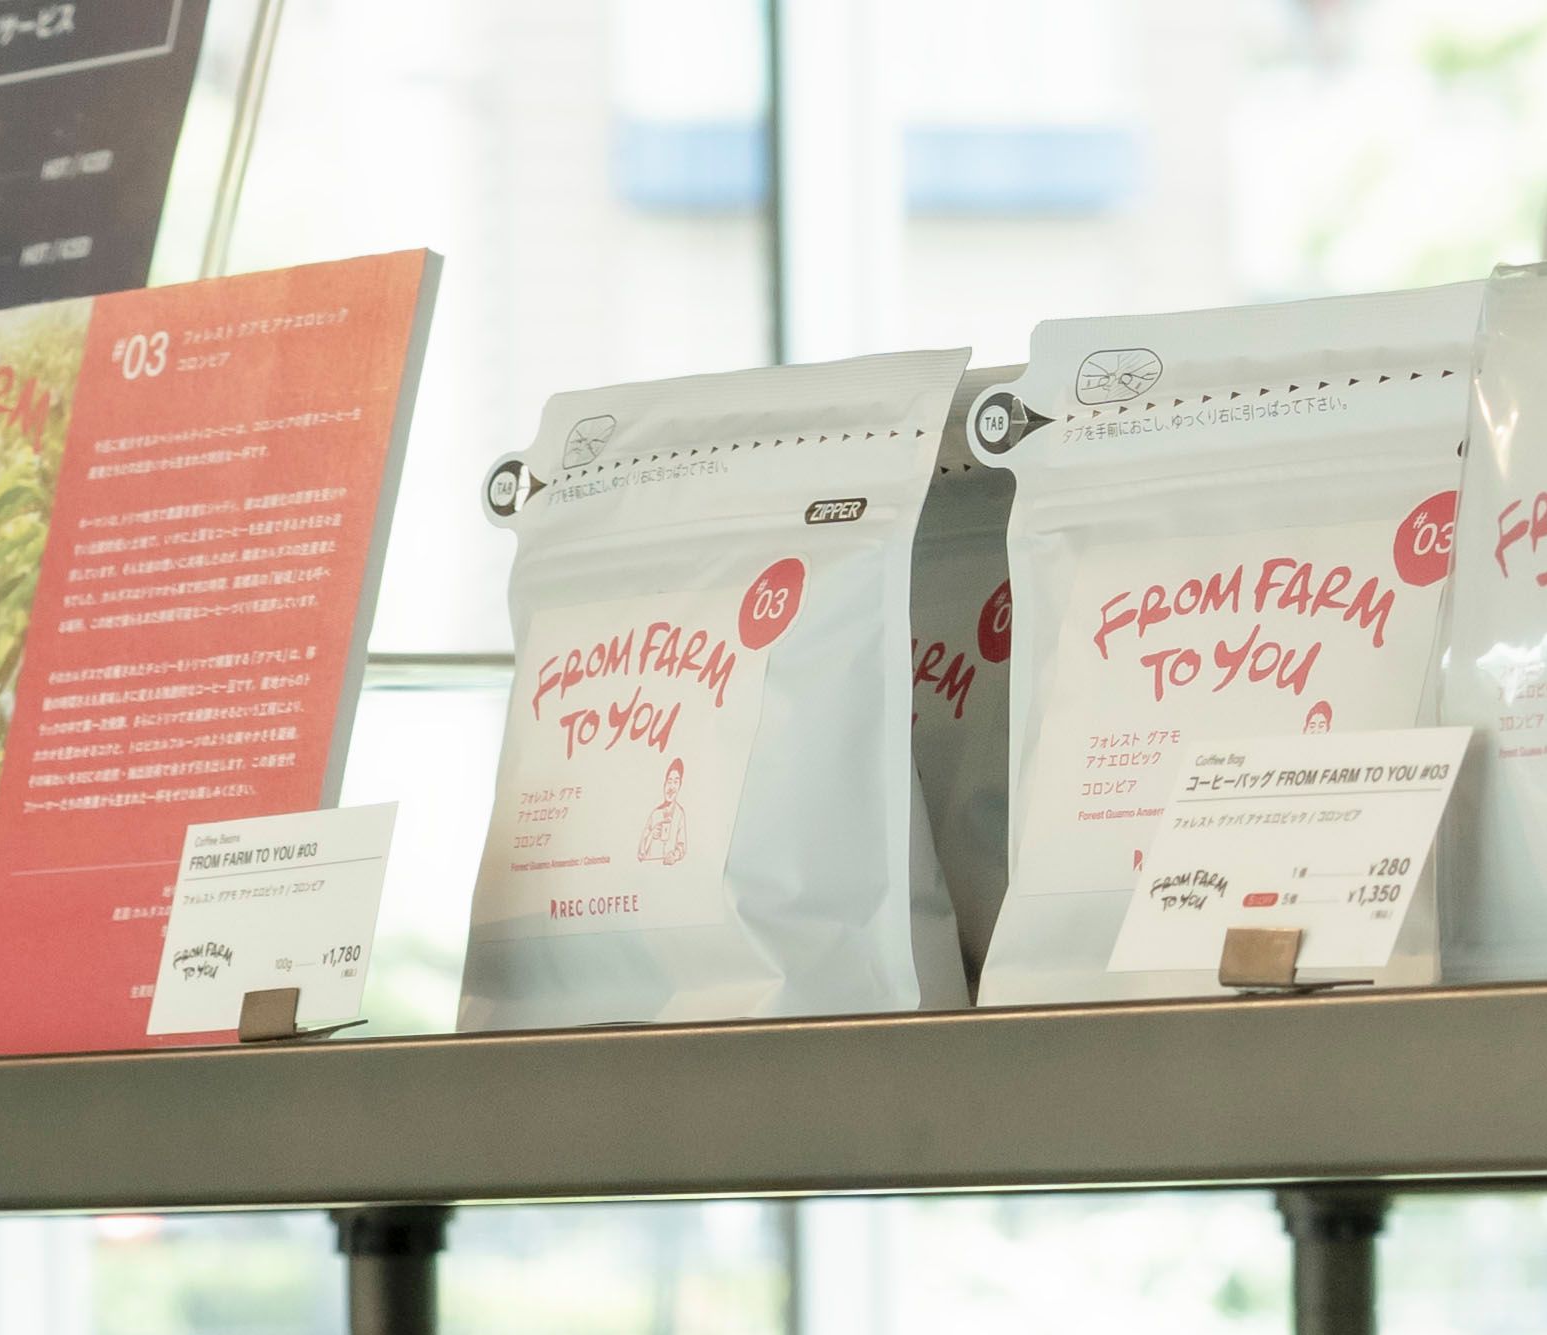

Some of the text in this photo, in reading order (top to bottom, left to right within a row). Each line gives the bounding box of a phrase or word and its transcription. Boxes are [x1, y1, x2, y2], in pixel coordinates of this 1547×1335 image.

[112, 331, 170, 380] #03
[984, 415, 1006, 431] TAB
[810, 500, 861, 521] ZIPPER
[1412, 511, 1454, 556] #03
[752, 577, 790, 620] #03
[1093, 557, 1396, 659] FROM FARM
[532, 621, 736, 720] FROM FARM
[1140, 623, 1323, 702] TO YOU
[911, 640, 976, 720] RM
[559, 686, 682, 760] TO YOU
[1089, 730, 1181, 750] フォレスト グアモ
[1085, 752, 1162, 768] アナエロビック
[1081, 779, 1138, 797] コロンビア
[1186, 763, 1451, 792] コーヒーバッグ FROM FARM TO YOU #03
[189, 842, 318, 871] FROM FARM TO YOU #03
[1368, 858, 1411, 877] ¥280
[1150, 869, 1229, 898] FROM FARM
[1348, 884, 1402, 906] ¥1,350
[560, 894, 639, 918] REC COFFEE
[173, 941, 233, 969] FROM FARM
